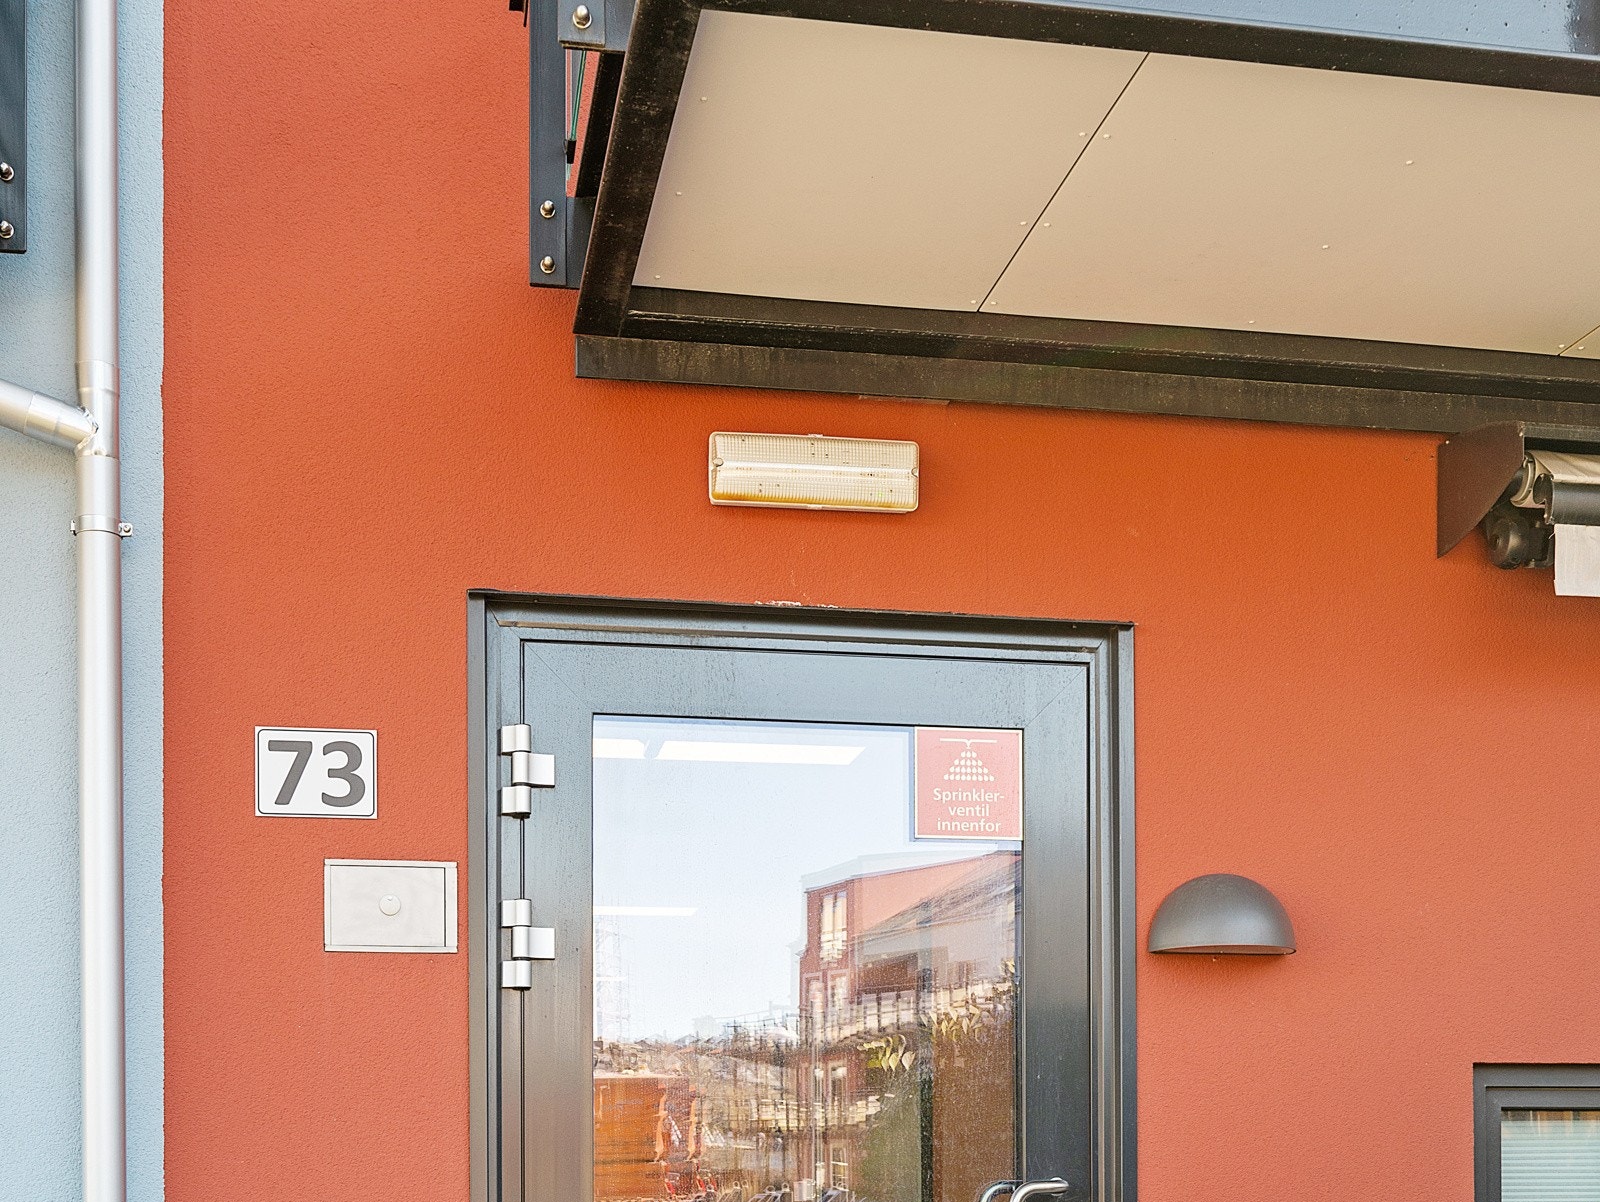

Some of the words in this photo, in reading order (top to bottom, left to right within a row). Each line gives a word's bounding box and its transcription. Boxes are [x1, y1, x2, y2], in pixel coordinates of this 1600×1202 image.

[267, 739, 366, 808] 73
[933, 787, 1005, 803] Sprinkler-
[948, 804, 990, 817] ventil
[937, 818, 1002, 833] innenfor
